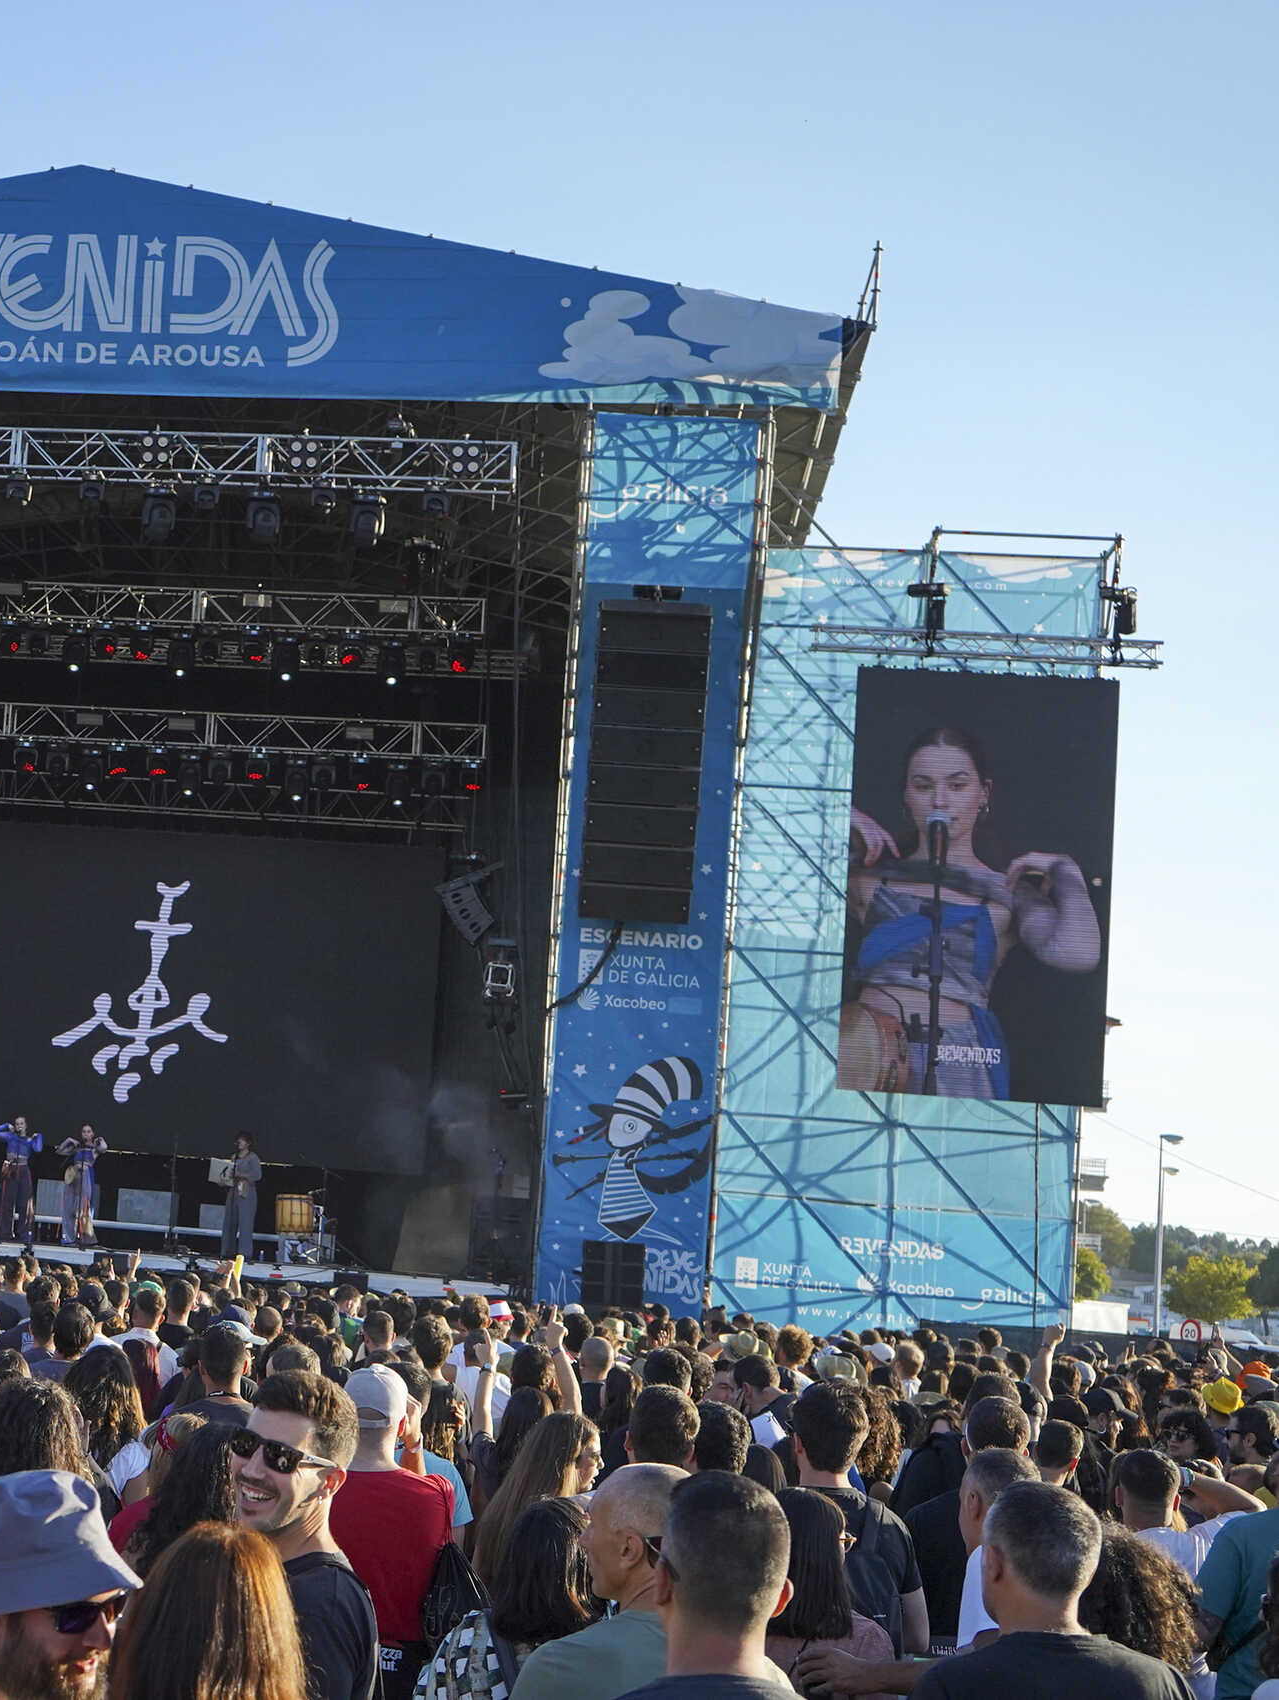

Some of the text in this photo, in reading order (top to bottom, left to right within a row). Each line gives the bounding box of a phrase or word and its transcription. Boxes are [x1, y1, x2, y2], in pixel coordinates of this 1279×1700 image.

[76, 343, 117, 365] DE
[128, 344, 265, 368] AROUSA
[610, 954, 666, 970] XUNTA
[608, 970, 700, 989] DE GALICIA
[604, 994, 667, 1011] Xacobeo
[841, 1237, 945, 1260] REVENIDAS
[762, 1262, 812, 1278] XUNTA
[761, 1276, 843, 1294] DE GALICIA
[887, 1280, 955, 1298] Xacobeo
[961, 1286, 1046, 1311] galicia
[1184, 1328, 1196, 1339] 20
